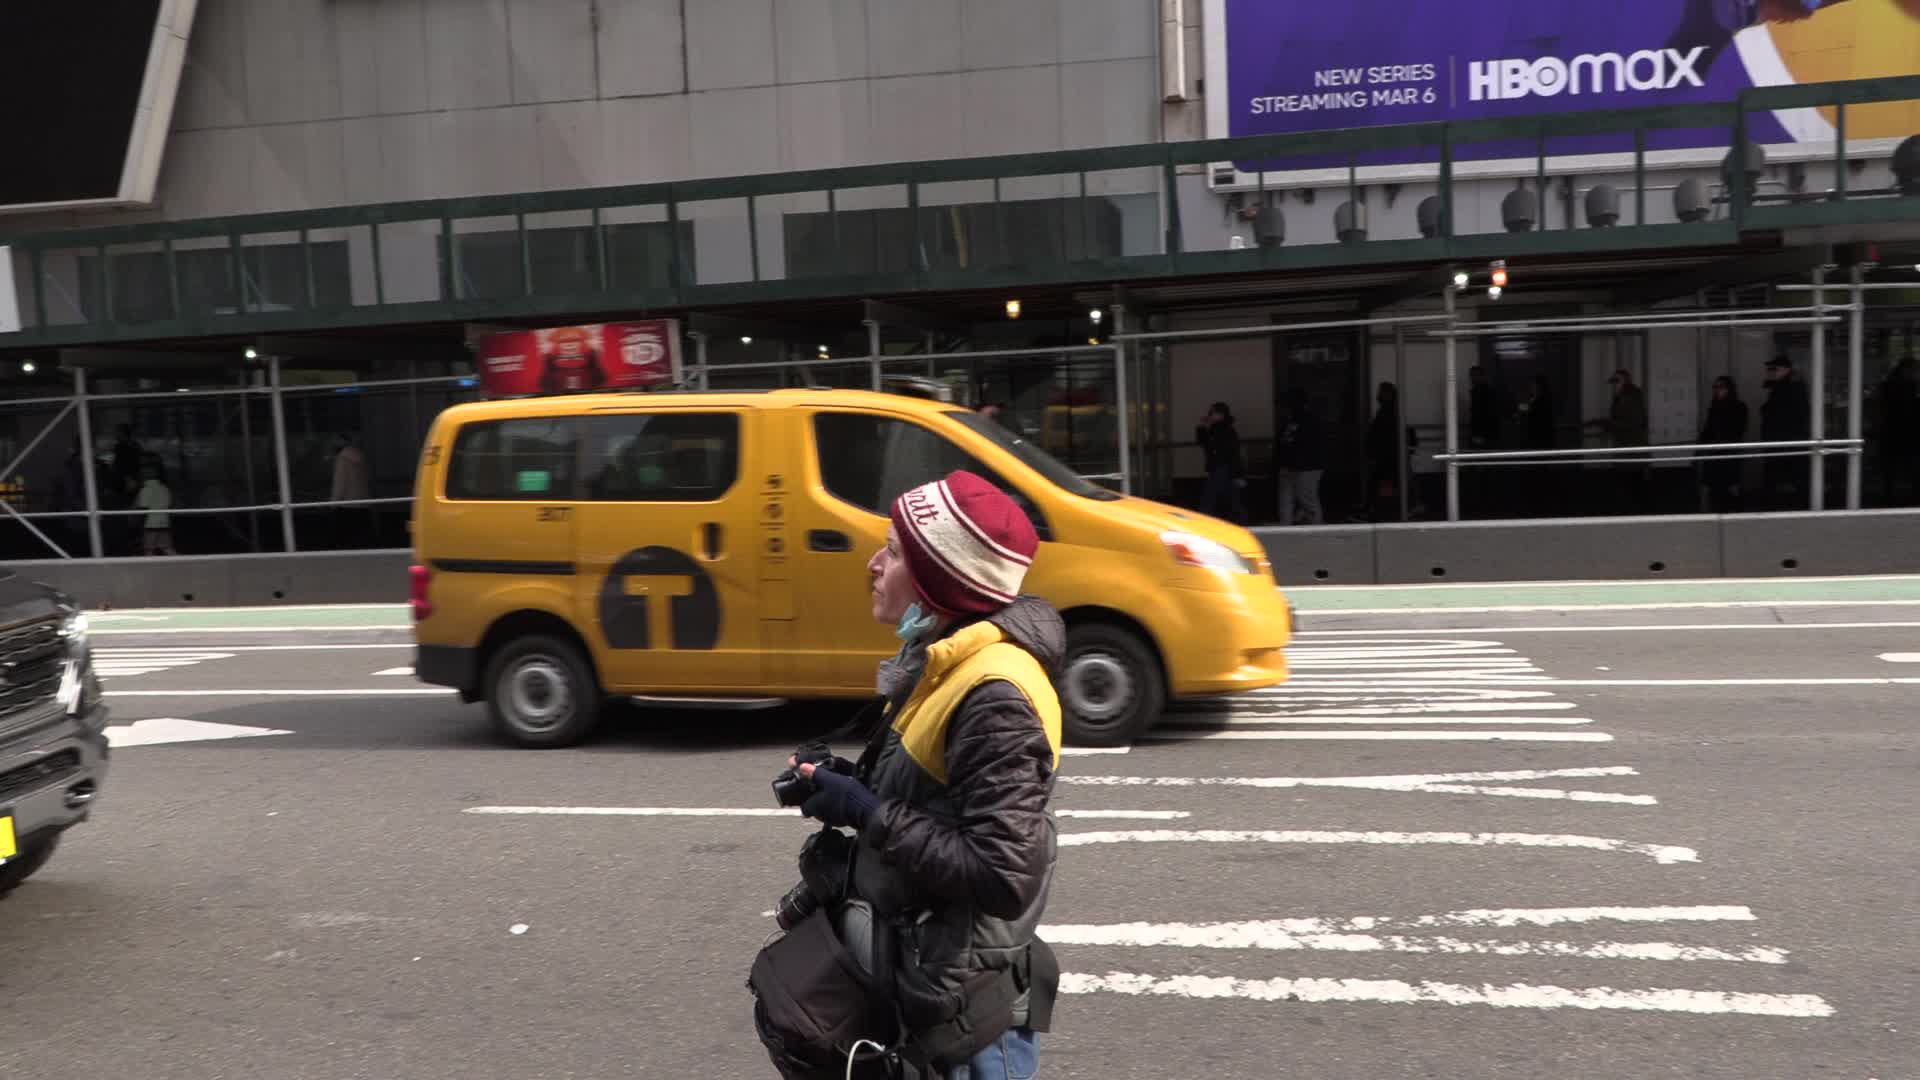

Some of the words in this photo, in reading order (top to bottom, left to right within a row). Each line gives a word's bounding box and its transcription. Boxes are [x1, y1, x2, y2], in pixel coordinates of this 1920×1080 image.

[1314, 68, 1363, 87] NEW
[1368, 63, 1436, 84] SERIES
[1250, 90, 1368, 114] STREAMING
[1372, 88, 1418, 107] MAR
[1422, 87, 1436, 104] 6
